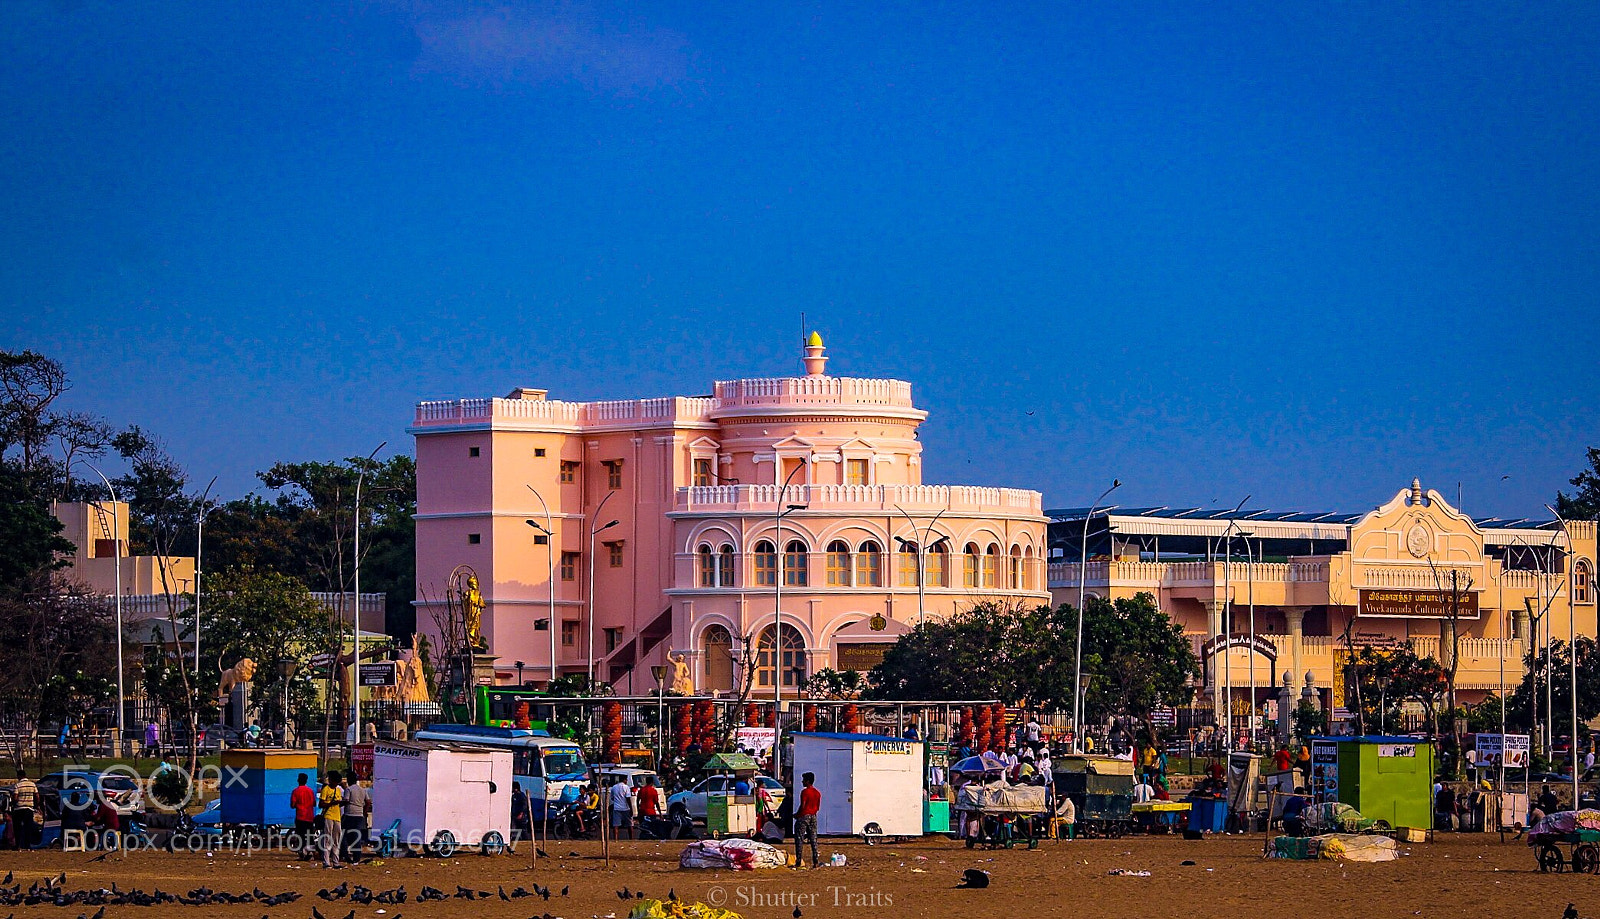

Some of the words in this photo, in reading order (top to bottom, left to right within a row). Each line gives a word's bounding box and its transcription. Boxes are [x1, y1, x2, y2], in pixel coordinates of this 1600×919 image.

[1365, 603, 1412, 613] Vivekananda
[1415, 603, 1445, 614] Cultural
[1447, 604, 1473, 615] Cntre
[374, 746, 421, 757] SPARTANS
[873, 741, 905, 752] MINERVA
